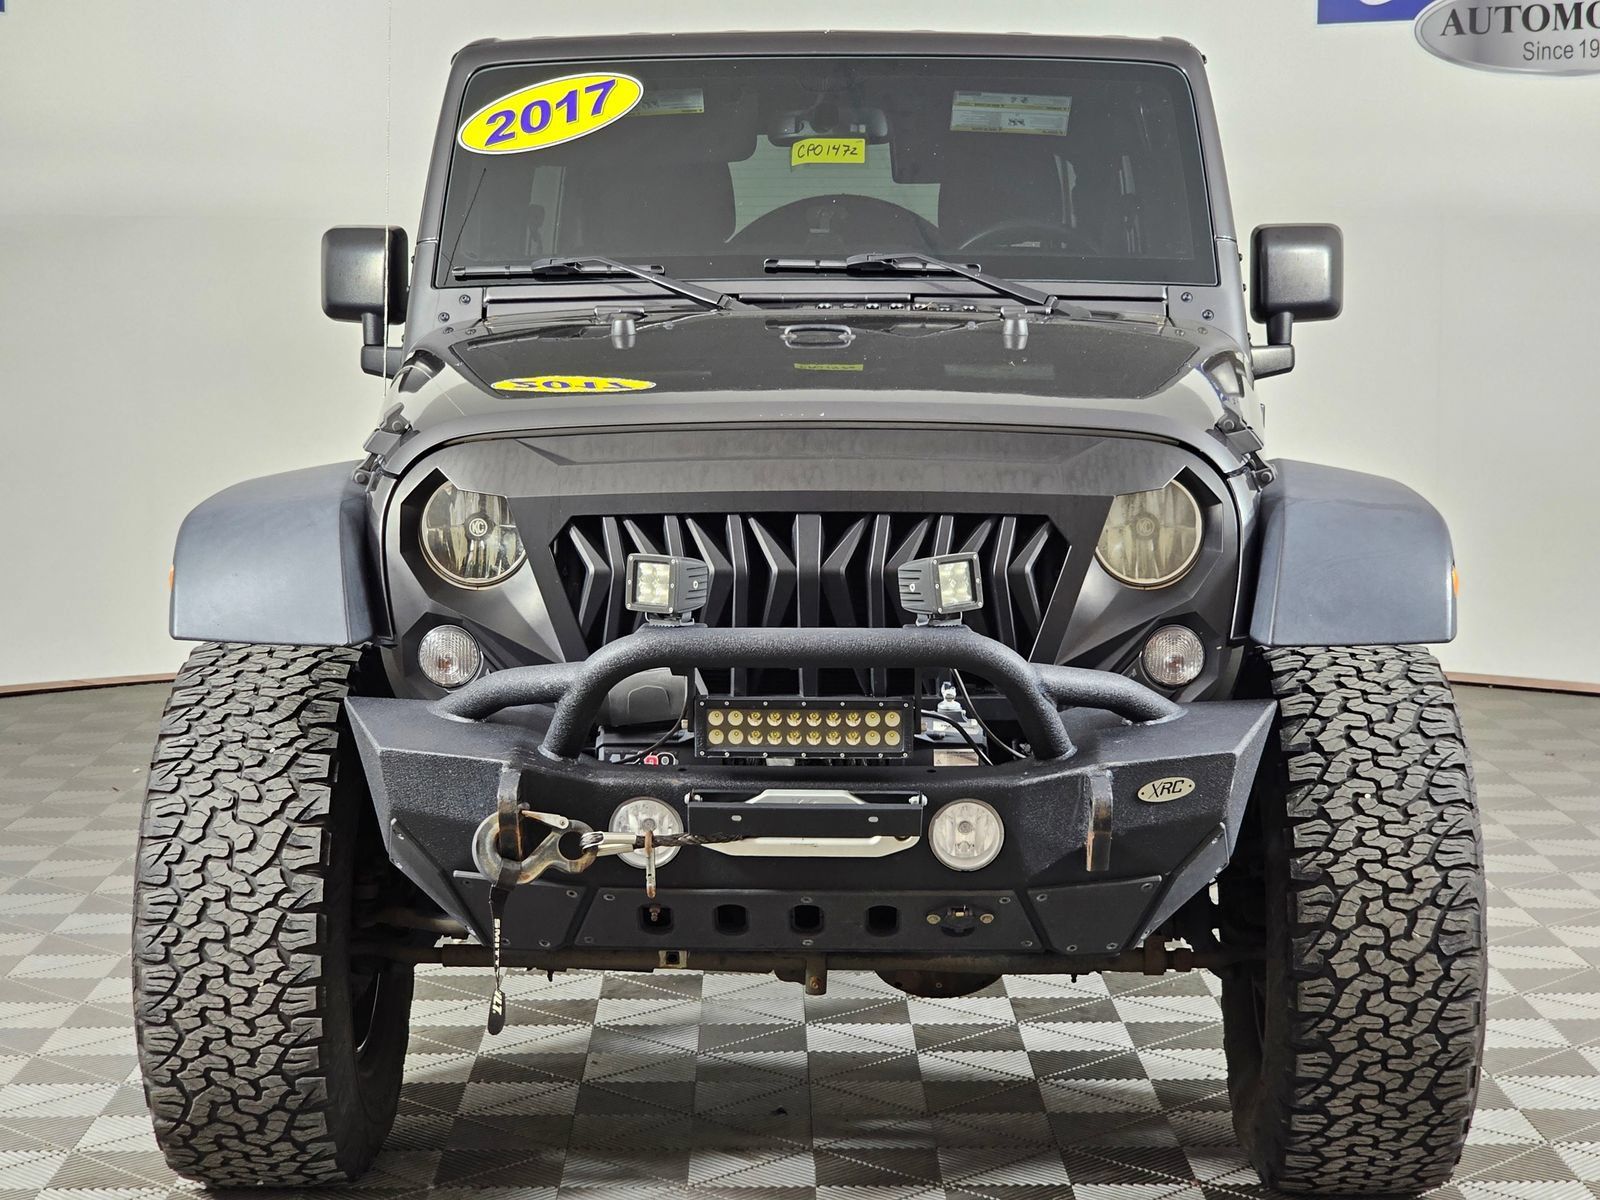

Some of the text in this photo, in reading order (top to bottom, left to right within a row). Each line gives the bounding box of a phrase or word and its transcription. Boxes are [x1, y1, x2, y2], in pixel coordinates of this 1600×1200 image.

[1522, 41, 1574, 61] Since
[484, 78, 618, 147] 2017
[1148, 780, 1184, 799] XRC
